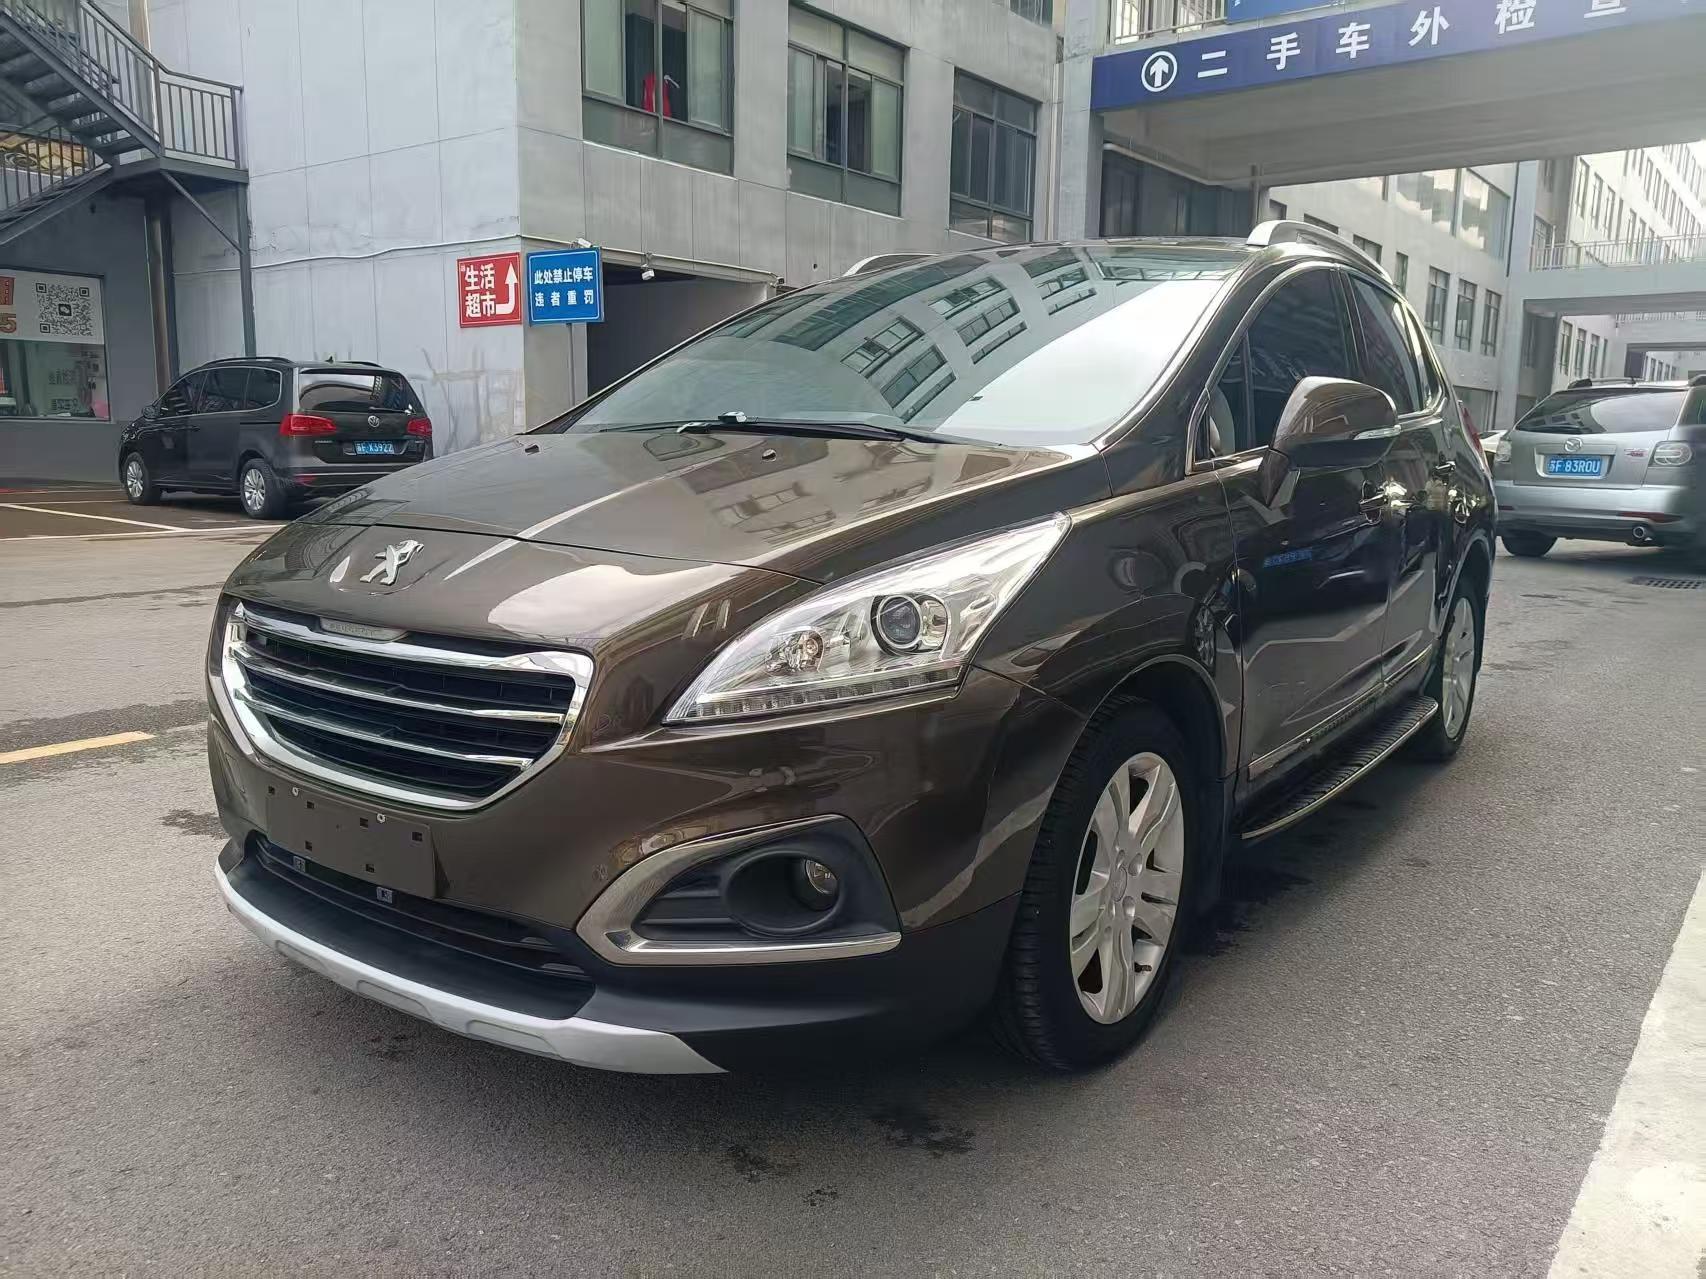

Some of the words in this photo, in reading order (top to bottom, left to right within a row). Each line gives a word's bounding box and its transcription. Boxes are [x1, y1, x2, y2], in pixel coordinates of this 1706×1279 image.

[464, 263, 496, 291] 生活
[534, 266, 594, 285] 此处禁止停车
[465, 292, 497, 318] 超市
[534, 289, 594, 307] 违者重罚
